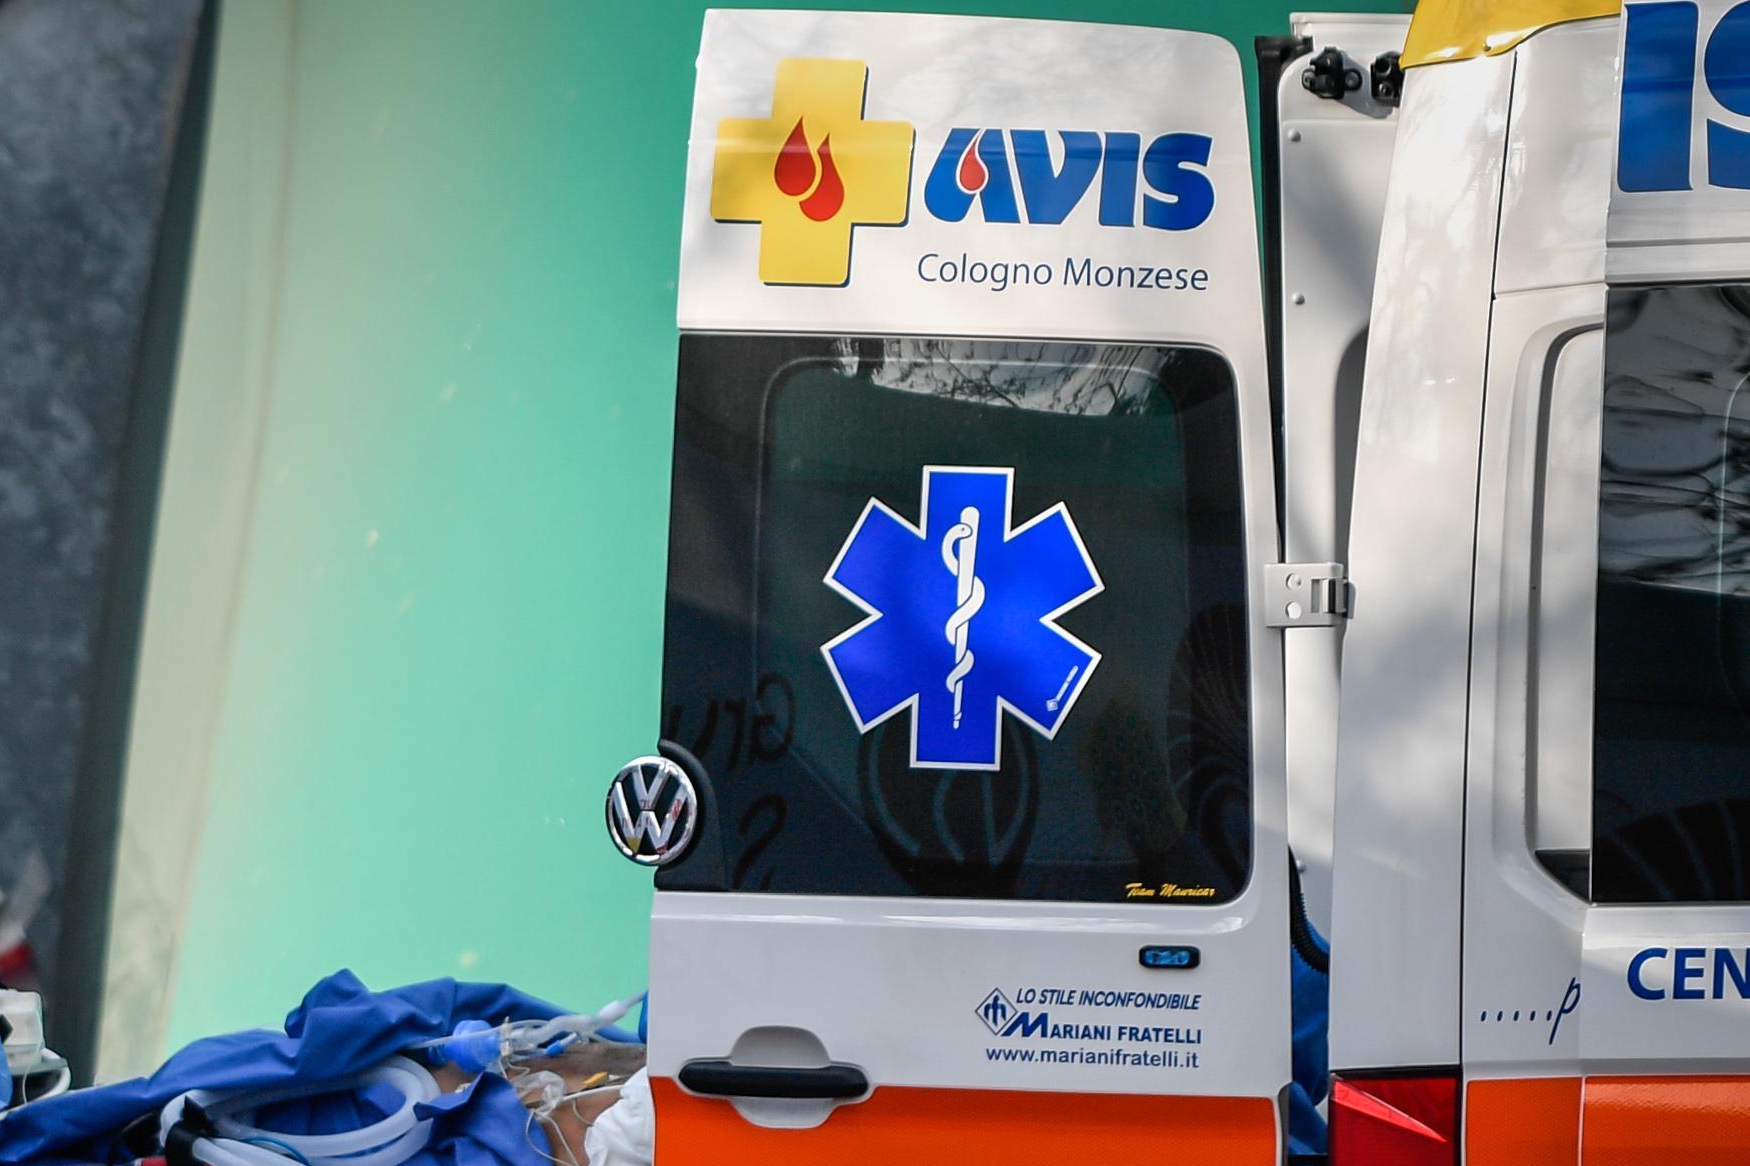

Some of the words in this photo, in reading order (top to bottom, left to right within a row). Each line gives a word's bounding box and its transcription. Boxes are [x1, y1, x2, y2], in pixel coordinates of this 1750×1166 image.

[923, 128, 1214, 231] AVIS
[918, 253, 1053, 292] Cologno
[1063, 257, 1209, 291] Monzese
[1126, 882, 1156, 898] Team
[1016, 988, 1037, 1004] LO
[1039, 989, 1077, 1006] STILE
[1079, 990, 1203, 1011] INCONFONDIBILE
[1001, 1012, 1112, 1041] MARIANI
[1117, 1025, 1203, 1045] FRATELLI
[986, 1047, 1200, 1069] www.marianifratelli.it
